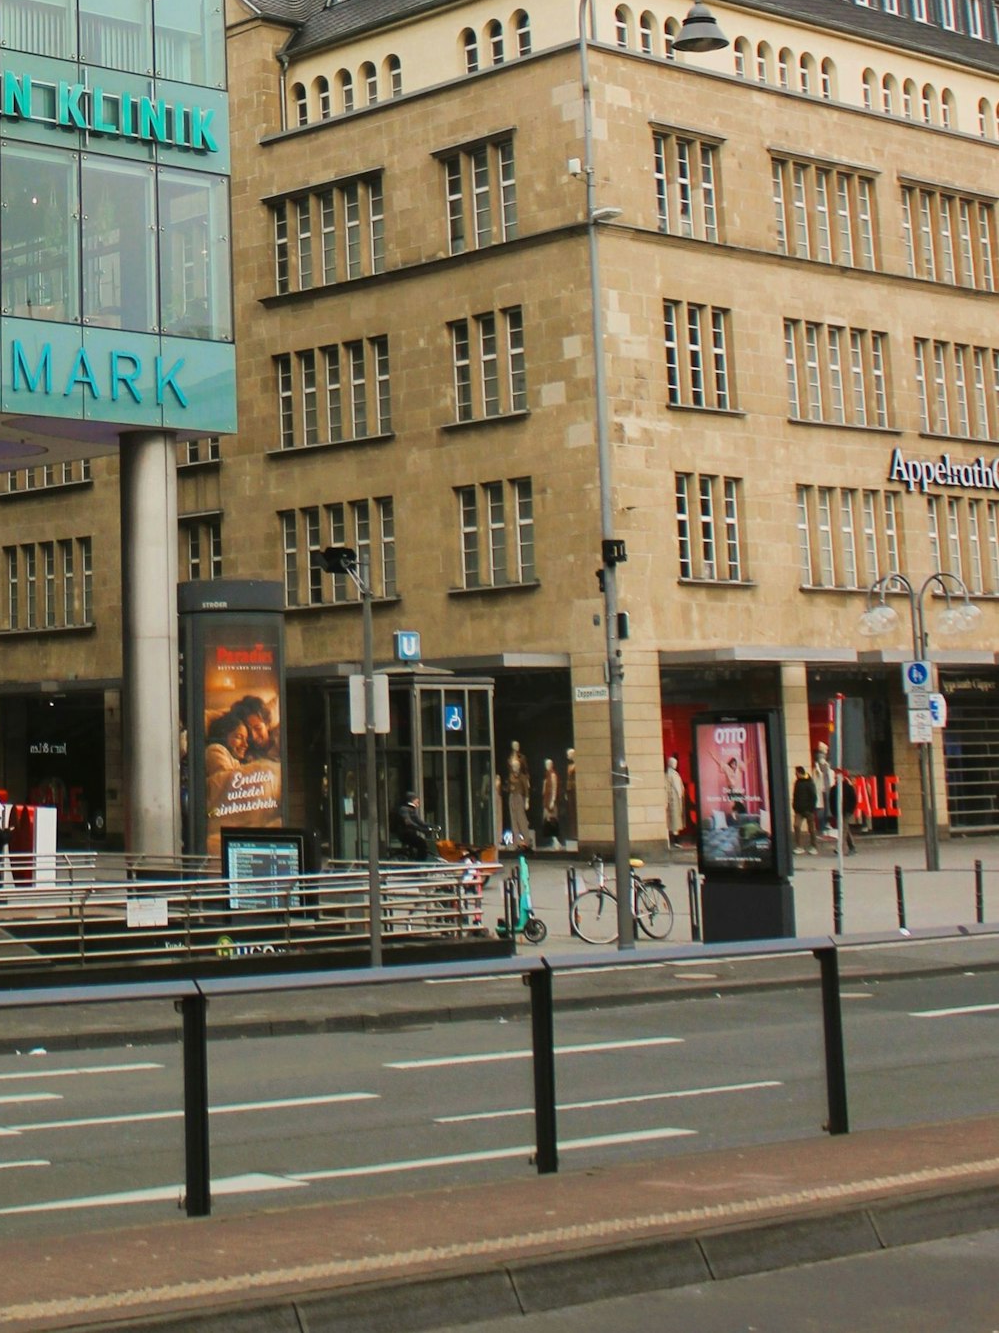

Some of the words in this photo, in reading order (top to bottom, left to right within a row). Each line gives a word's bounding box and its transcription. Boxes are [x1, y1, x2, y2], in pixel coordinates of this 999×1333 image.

[56, 80, 219, 153] KLINIK
[402, 636, 417, 656] U
[714, 727, 746, 744] OTTO
[855, 776, 902, 817] ALE
